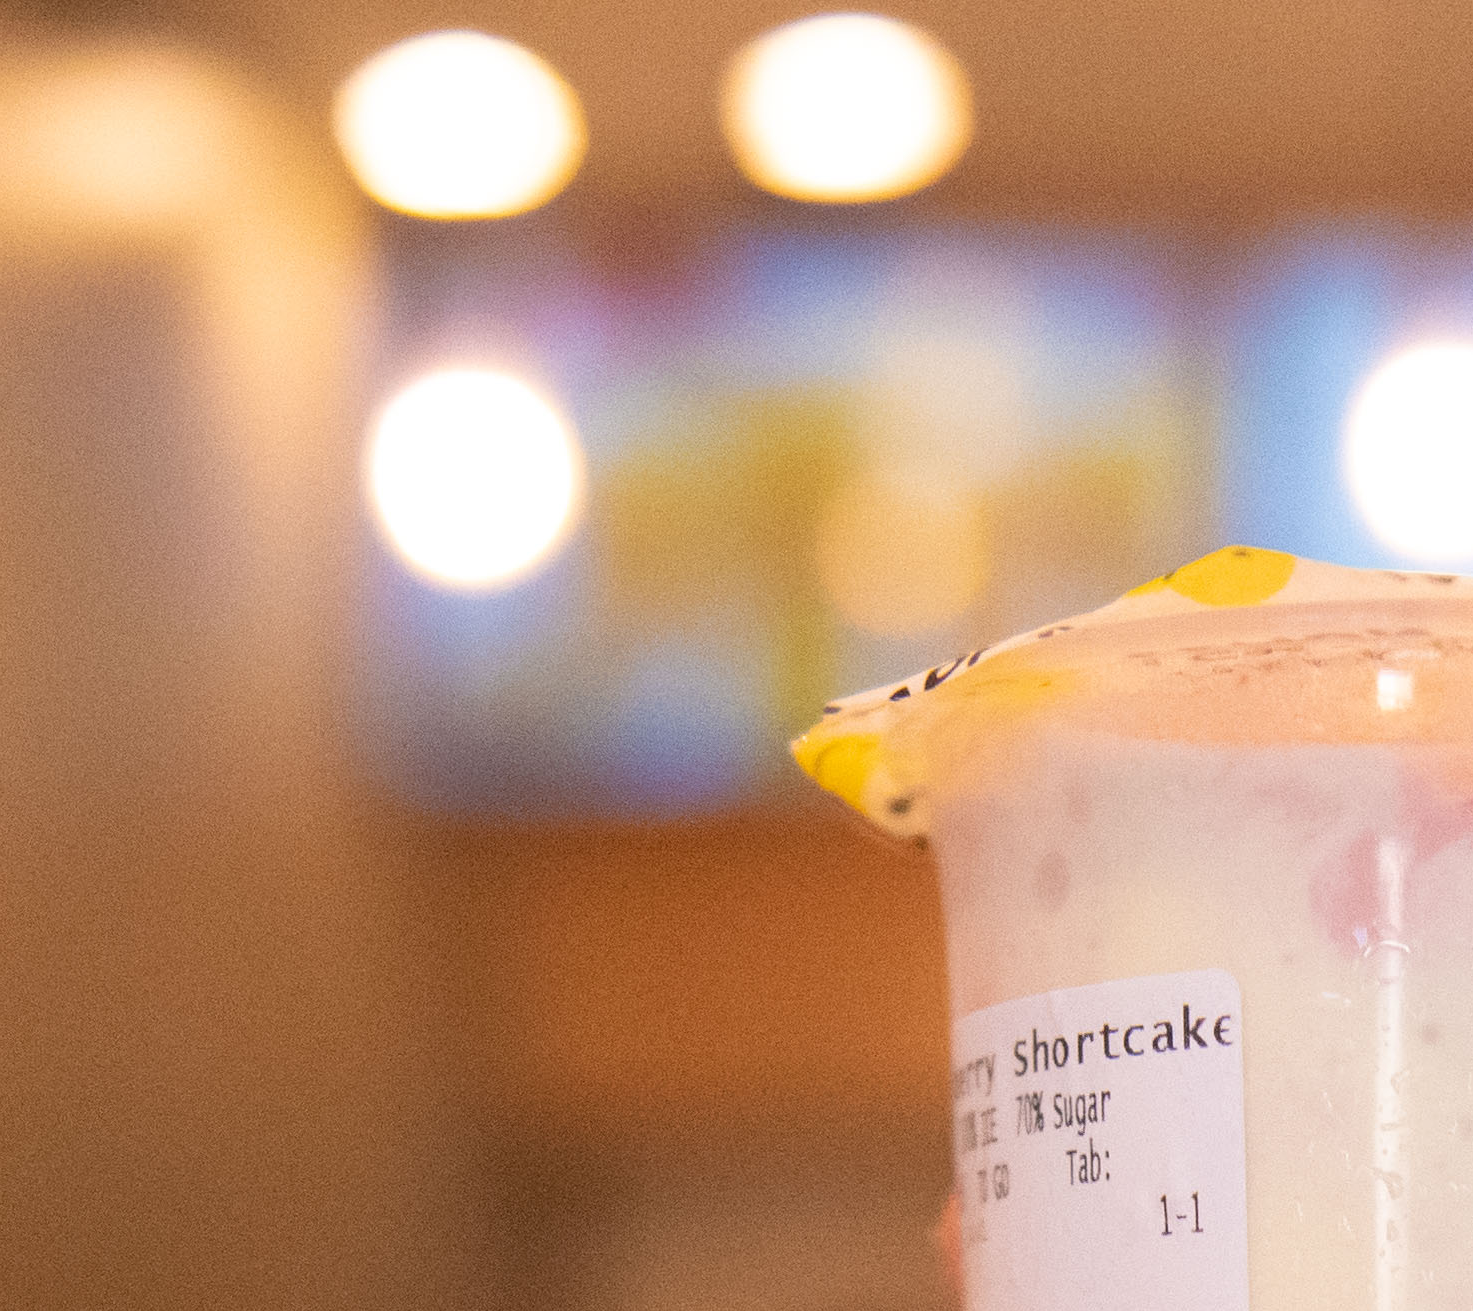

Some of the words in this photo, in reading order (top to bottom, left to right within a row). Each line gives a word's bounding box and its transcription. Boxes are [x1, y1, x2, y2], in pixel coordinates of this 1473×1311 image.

[1016, 1091, 1044, 1136] 70%
[1066, 1137, 1110, 1186] Tab:
[1159, 1190, 1204, 1236] 1-1
